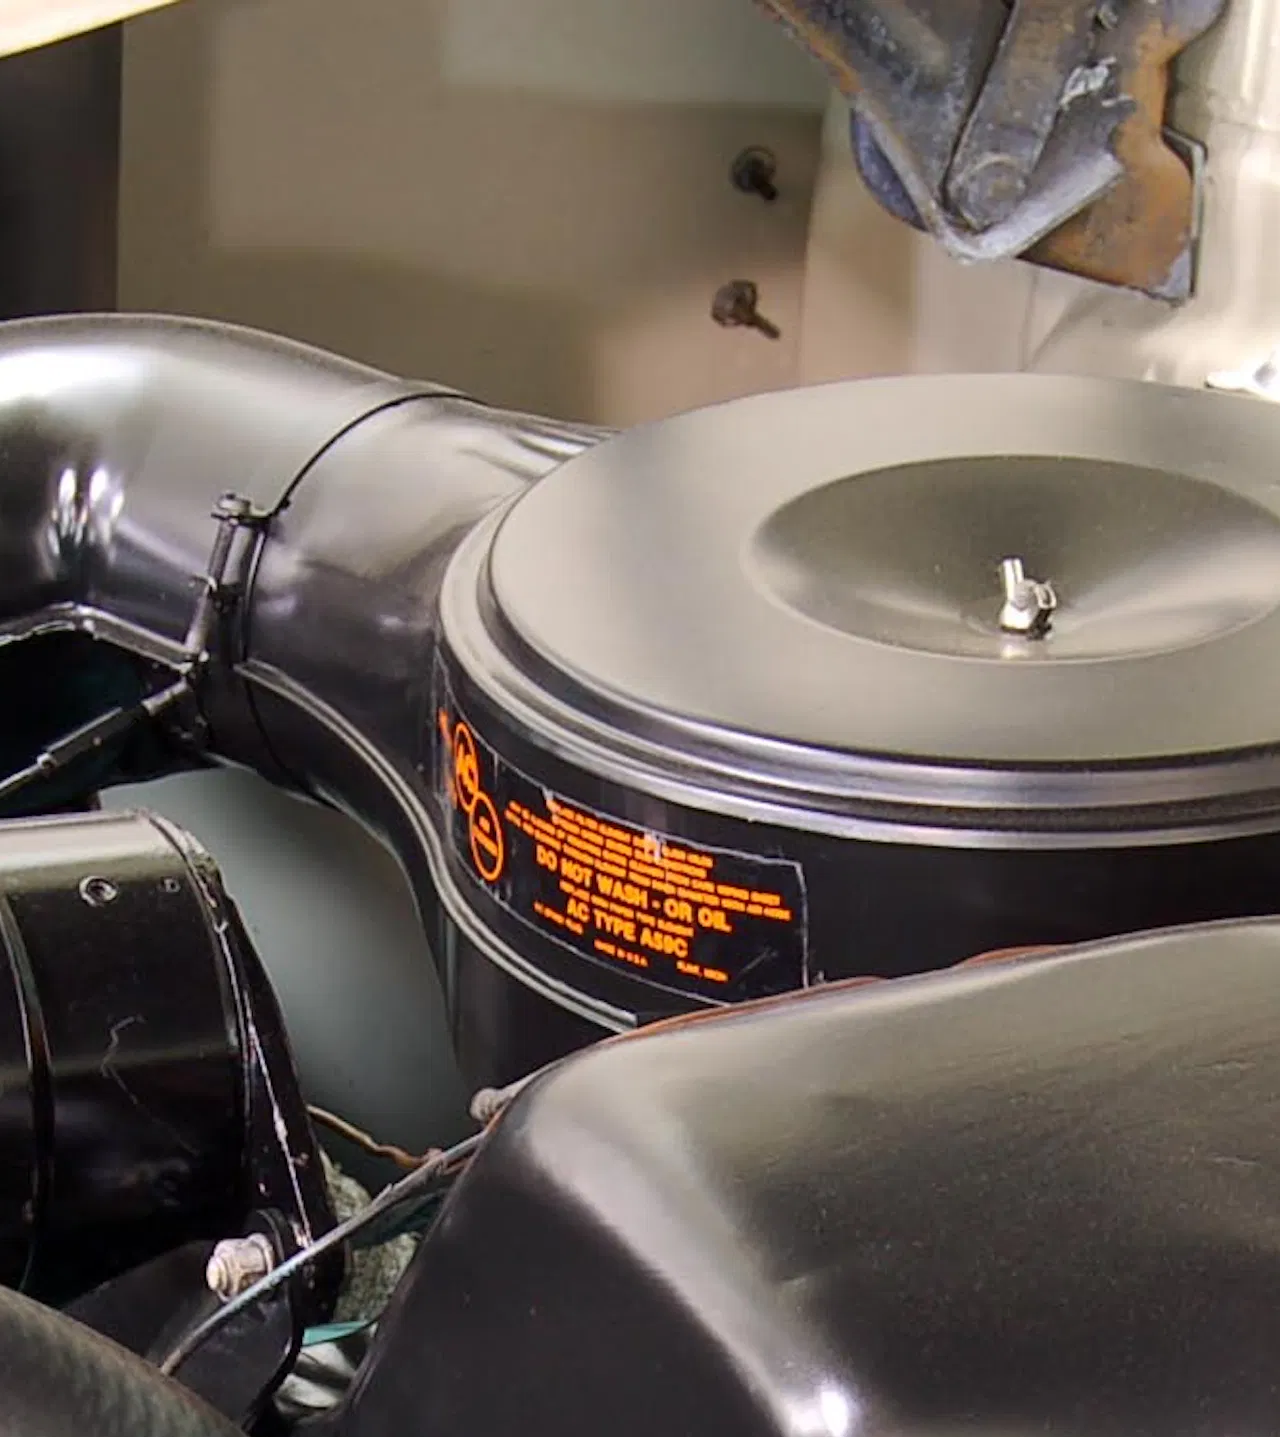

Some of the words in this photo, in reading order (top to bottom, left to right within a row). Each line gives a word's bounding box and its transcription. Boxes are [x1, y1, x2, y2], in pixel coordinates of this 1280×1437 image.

[535, 843, 559, 873] DO
[560, 857, 594, 889] NOT
[595, 872, 649, 911] WASH
[663, 897, 693, 924] OR
[566, 897, 590, 923] AC
[592, 907, 638, 943] TYPE
